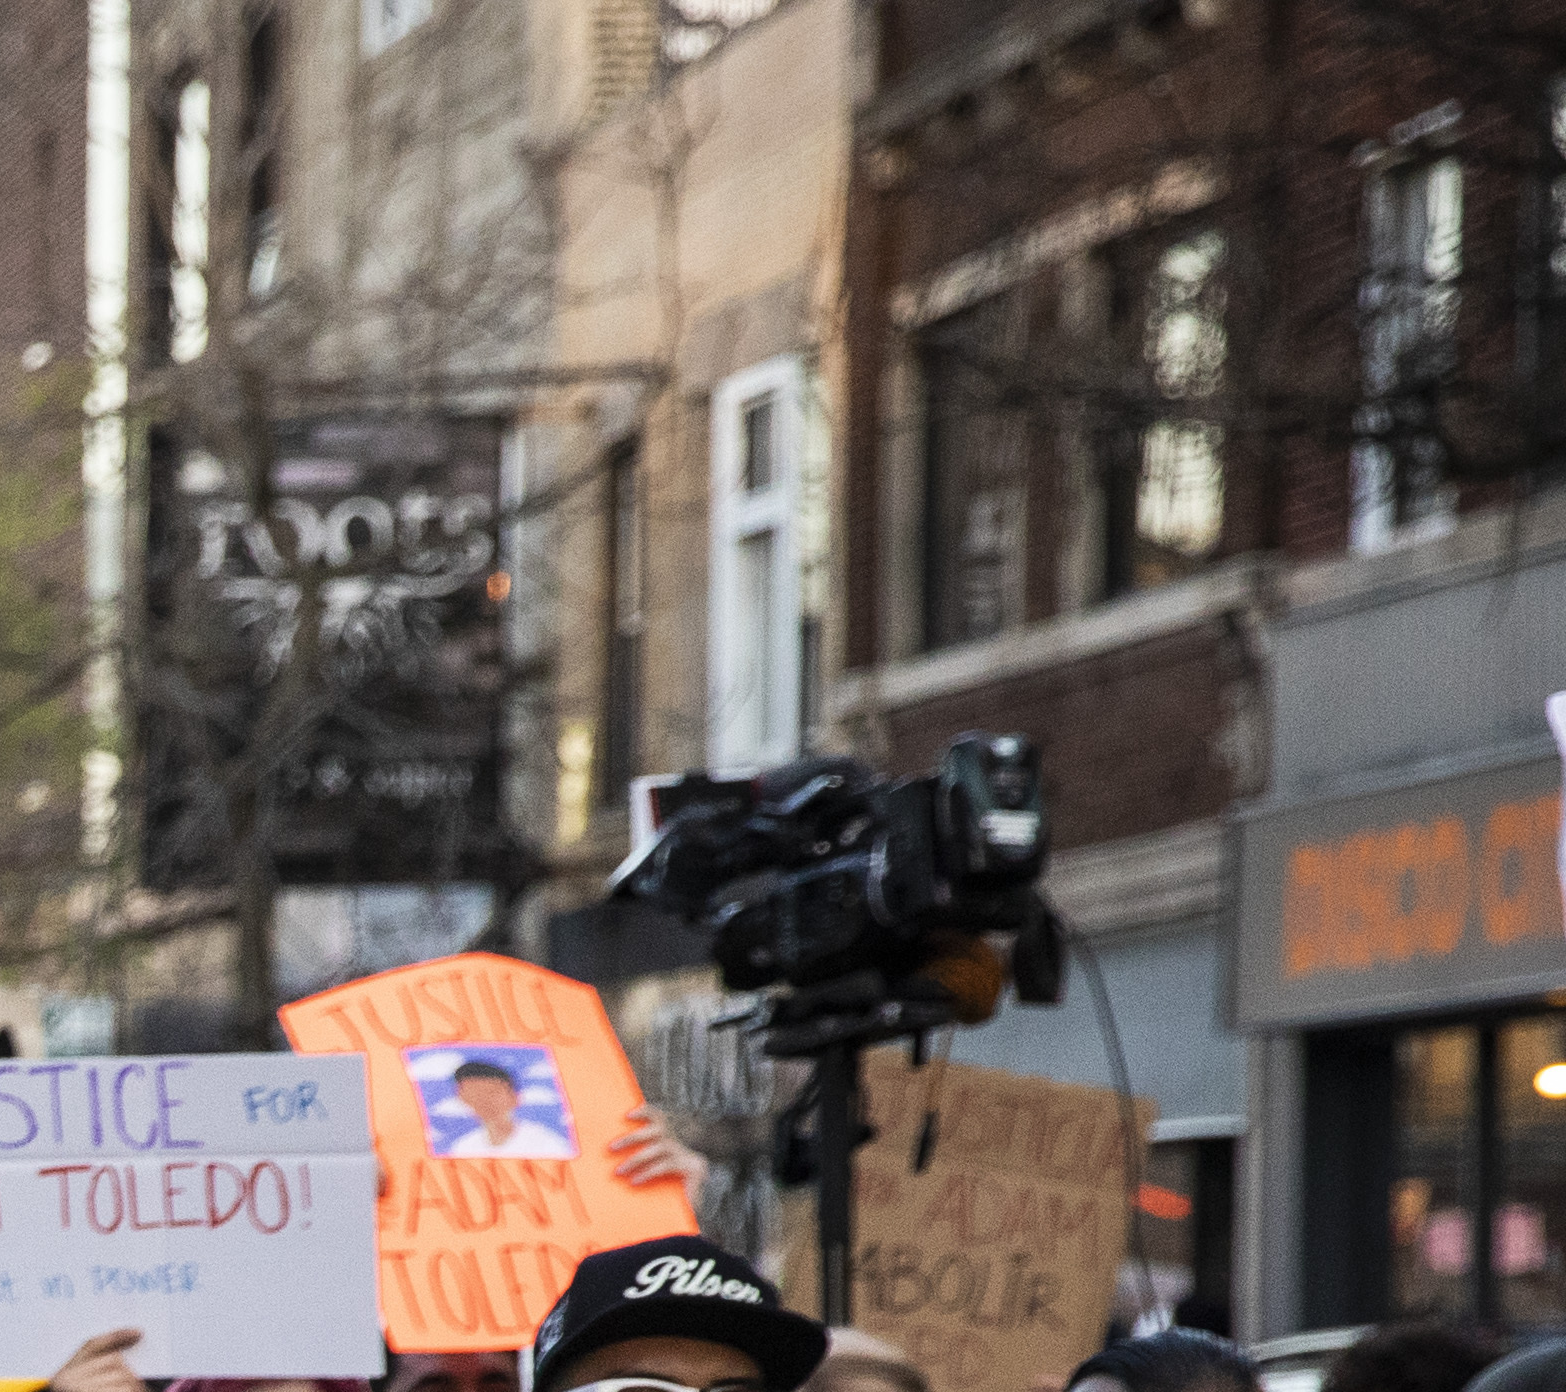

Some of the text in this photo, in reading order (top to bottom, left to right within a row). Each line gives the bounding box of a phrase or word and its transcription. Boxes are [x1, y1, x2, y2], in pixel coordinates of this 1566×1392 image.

[243, 1082, 328, 1126] FOR
[39, 1160, 314, 1237] TOLEDO!
[380, 1242, 594, 1336] TOLED
[622, 1255, 764, 1305] Pilsen
